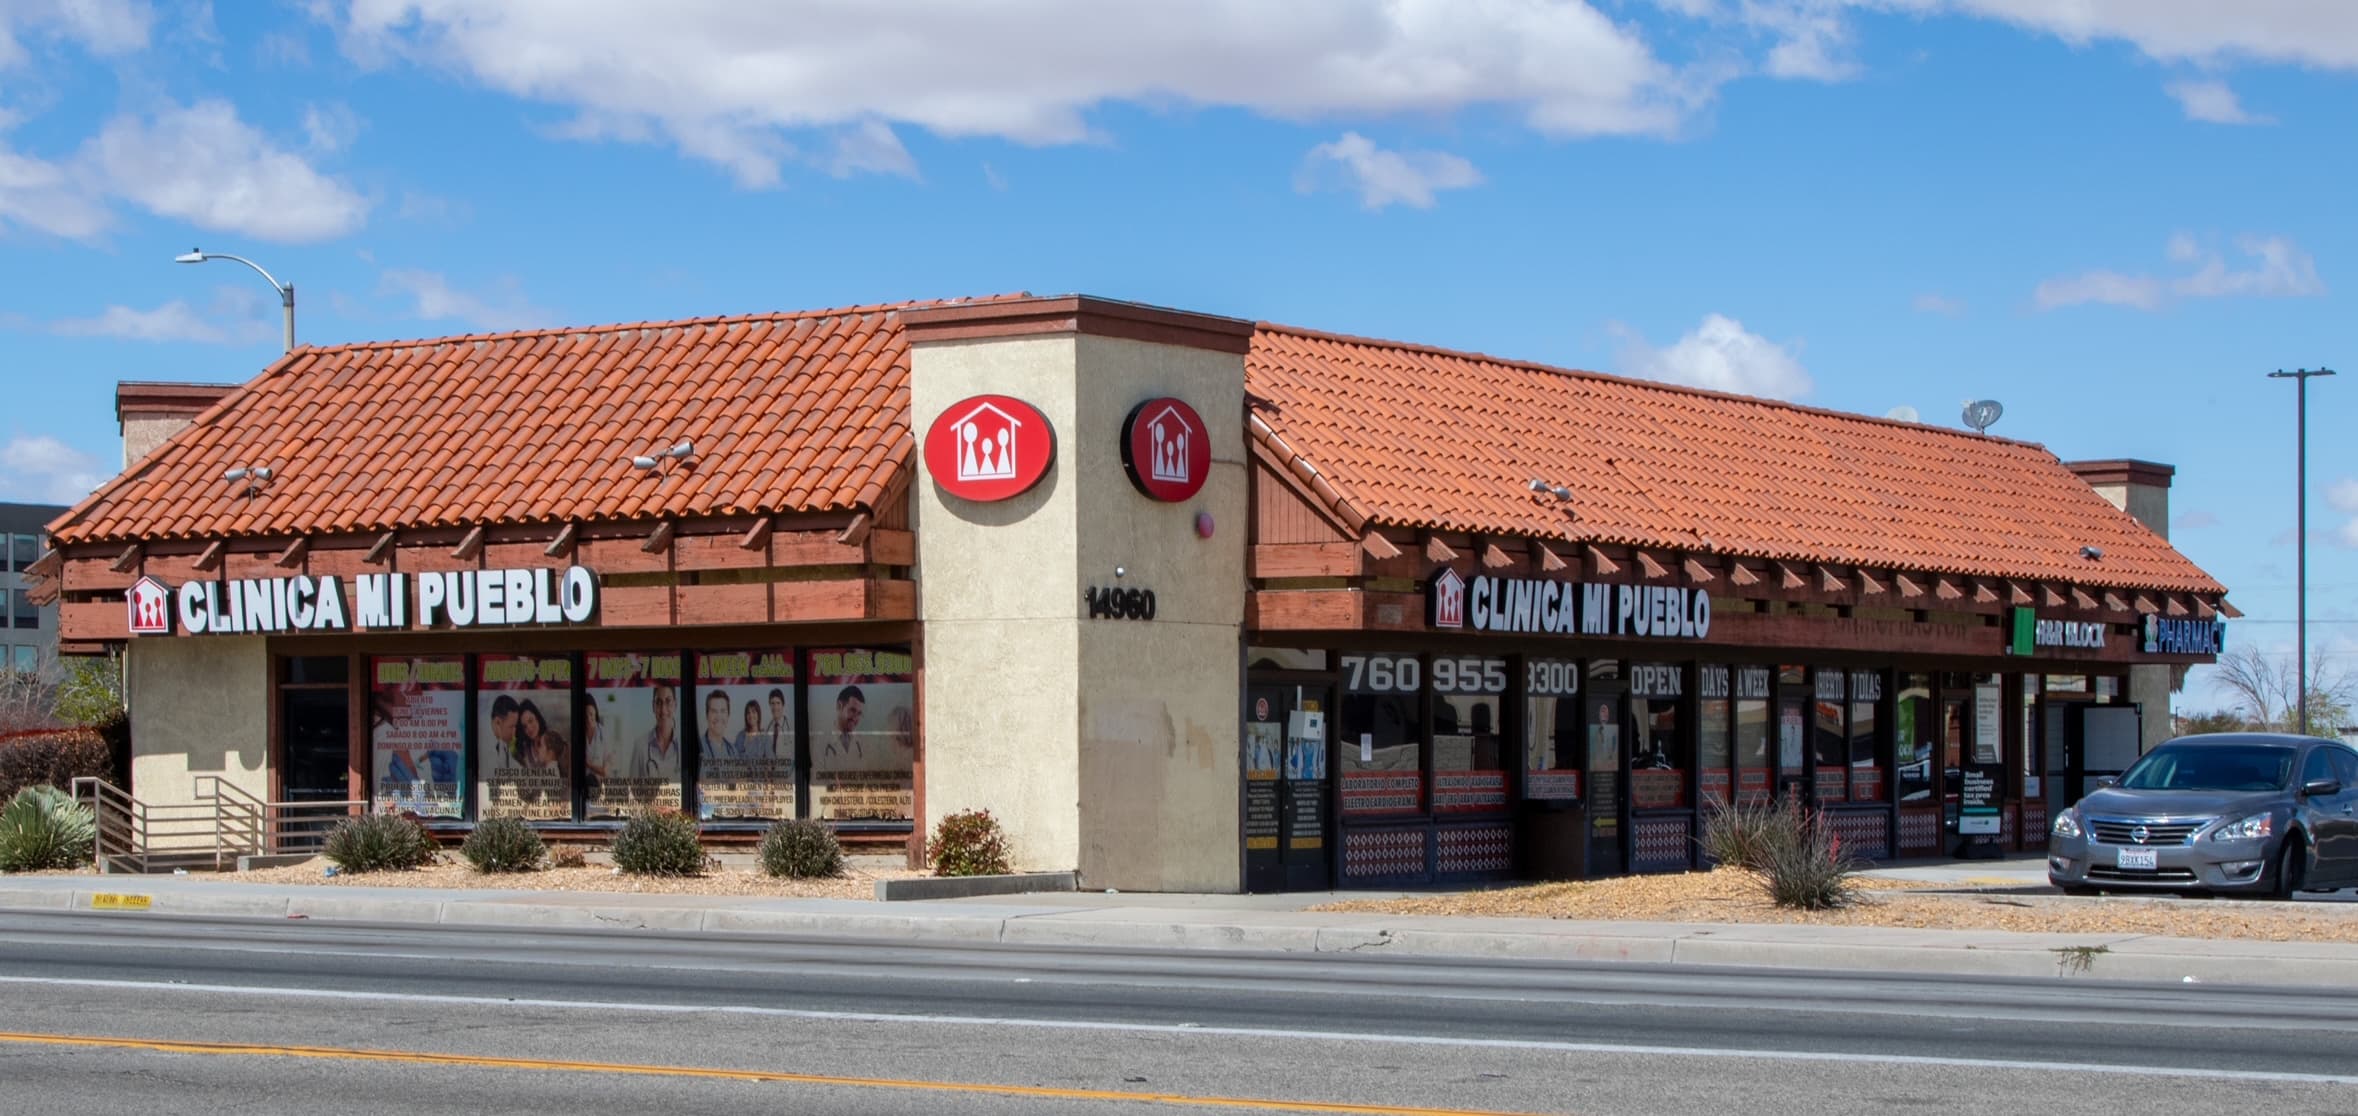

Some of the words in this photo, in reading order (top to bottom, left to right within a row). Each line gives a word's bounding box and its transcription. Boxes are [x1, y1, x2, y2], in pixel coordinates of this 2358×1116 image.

[179, 574, 346, 634] CLINICA
[356, 571, 405, 628] MI
[419, 565, 595, 627] PUEBLO
[1089, 586, 1156, 621] 14960
[1471, 575, 1575, 634] CLINICA
[1582, 582, 1611, 635] MI
[1618, 584, 1711, 639] PUEBLO
[2036, 619, 2063, 647] H&R
[2065, 621, 2107, 648] BLOCK
[2158, 618, 2226, 654] PHARMACY
[1341, 656, 1420, 692] 760
[1433, 658, 1506, 692] 955
[1631, 666, 1682, 695] OPEN
[1701, 667, 1729, 696] DAYS
[1744, 669, 1770, 697] WEEK
[1858, 672, 1881, 700] DIAS
